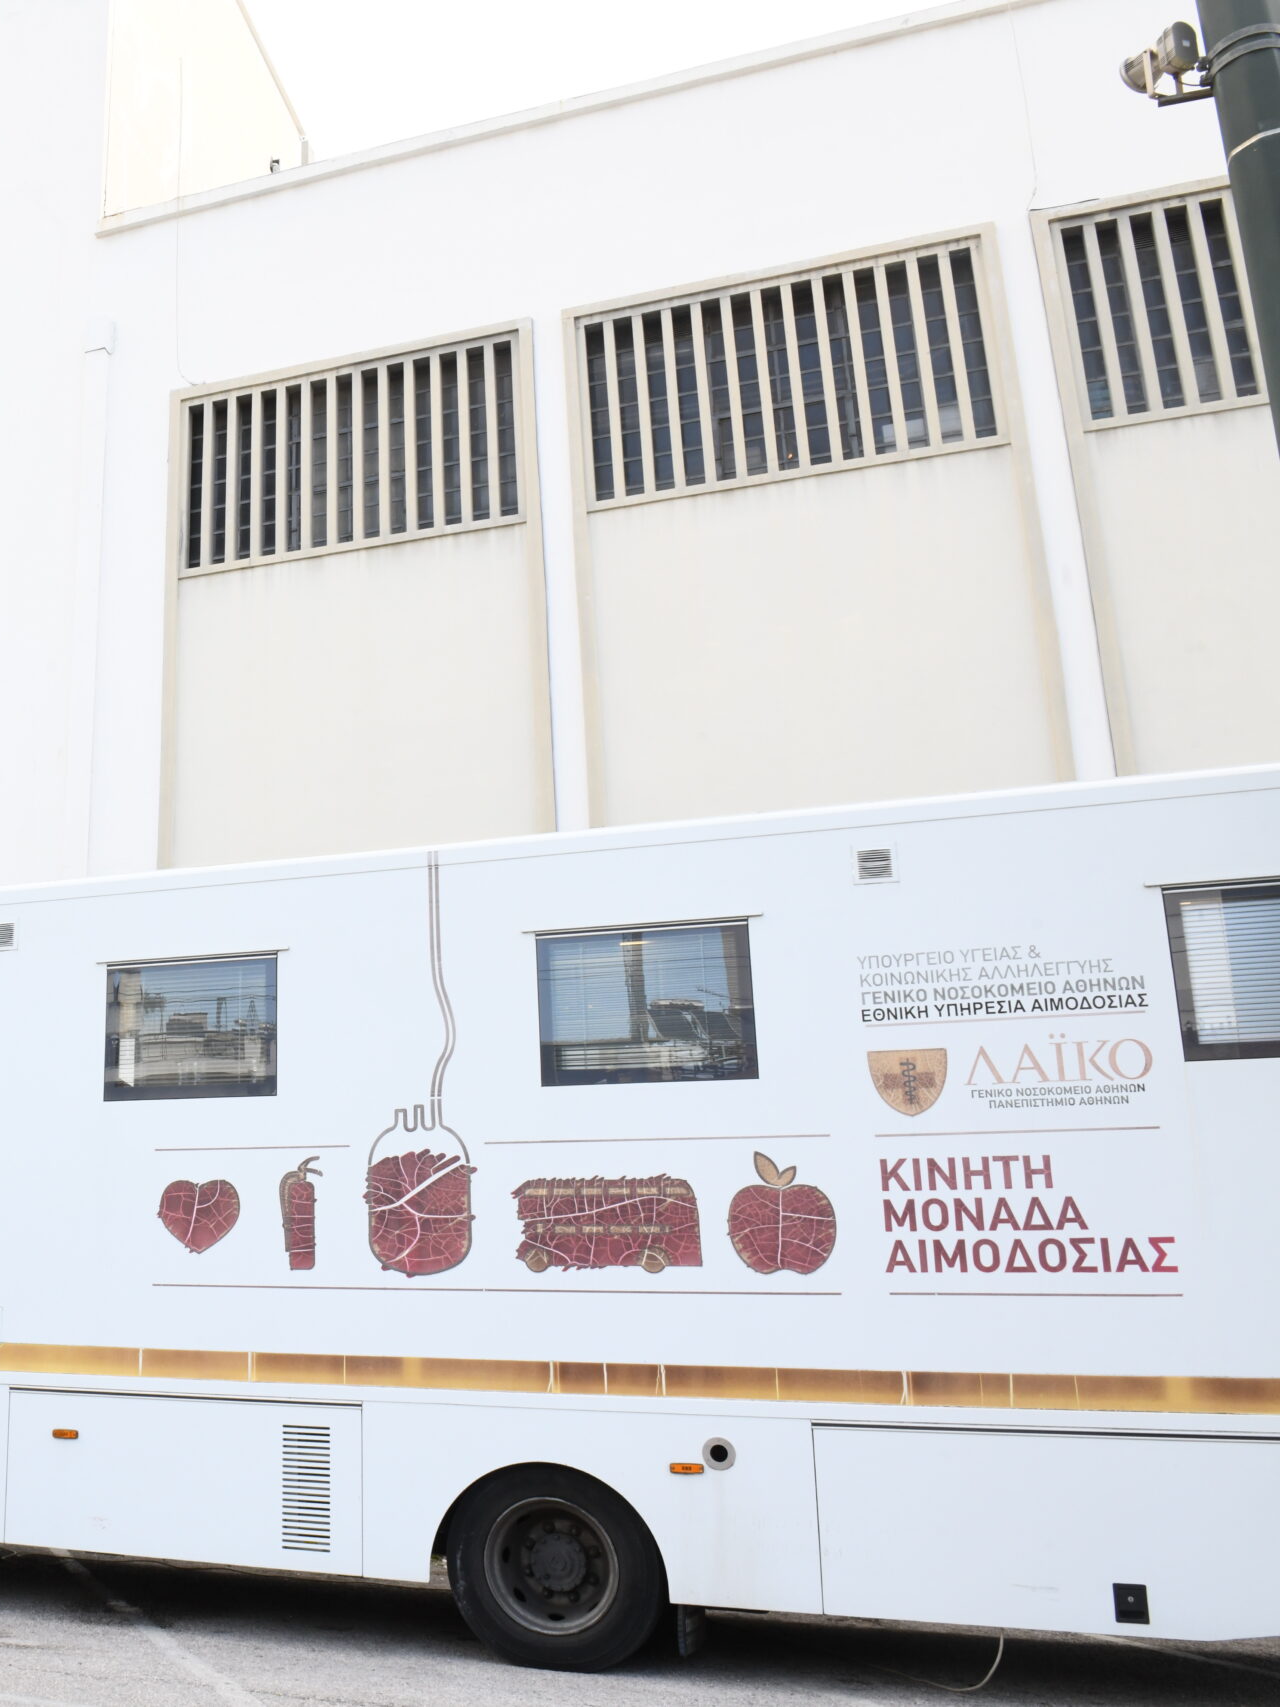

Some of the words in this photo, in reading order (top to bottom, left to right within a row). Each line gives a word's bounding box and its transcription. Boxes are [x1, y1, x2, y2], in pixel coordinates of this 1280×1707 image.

[857, 950, 955, 970] ΥΠΟΥΡΓΕΙΟ
[959, 945, 1023, 962] ΥΓΕΙΑΣ
[1028, 945, 1041, 959] &
[859, 967, 973, 987] ΚΟΙΝΩΝΙΚΗΣ
[977, 958, 1114, 981] ΑΛΛΗΛΕΓΓΥΗΣ
[861, 988, 928, 1005] ΓΕΝΙΚΟ
[933, 979, 1057, 1001] ΝΟΣΟΚΟΜΕΙΟ
[1062, 975, 1146, 994] ΑΘΗΝΩΝ
[861, 1005, 929, 1023] ΕΘΝΙΚΗ
[934, 999, 1026, 1017] ΥΠΗΡΕΣΙΑ
[1031, 993, 1150, 1012] ΑΙΜΟΔΟΣΙΑΣ
[964, 1032, 1153, 1086] ΛΑΪΚΟ
[970, 1088, 1013, 1099] ΓΕΝΙΚΟ
[1015, 1085, 1092, 1098] ΝΟΣΟΚΟΜΕΙΟ
[1095, 1083, 1146, 1094] ΑΘΗΝΩΝ
[988, 1097, 1076, 1110] ΠΑΝΕΠΙΣΤΗΜΙΟ
[1078, 1094, 1130, 1106] ΑΘΗΝΩΝ
[879, 1155, 1054, 1191] ΚΙΝΗΤΗ
[882, 1196, 1089, 1232] ΜΟΝΑΔΑ
[886, 1236, 1179, 1273] ΑΙΜΟΔΟΣΙΑΣ
